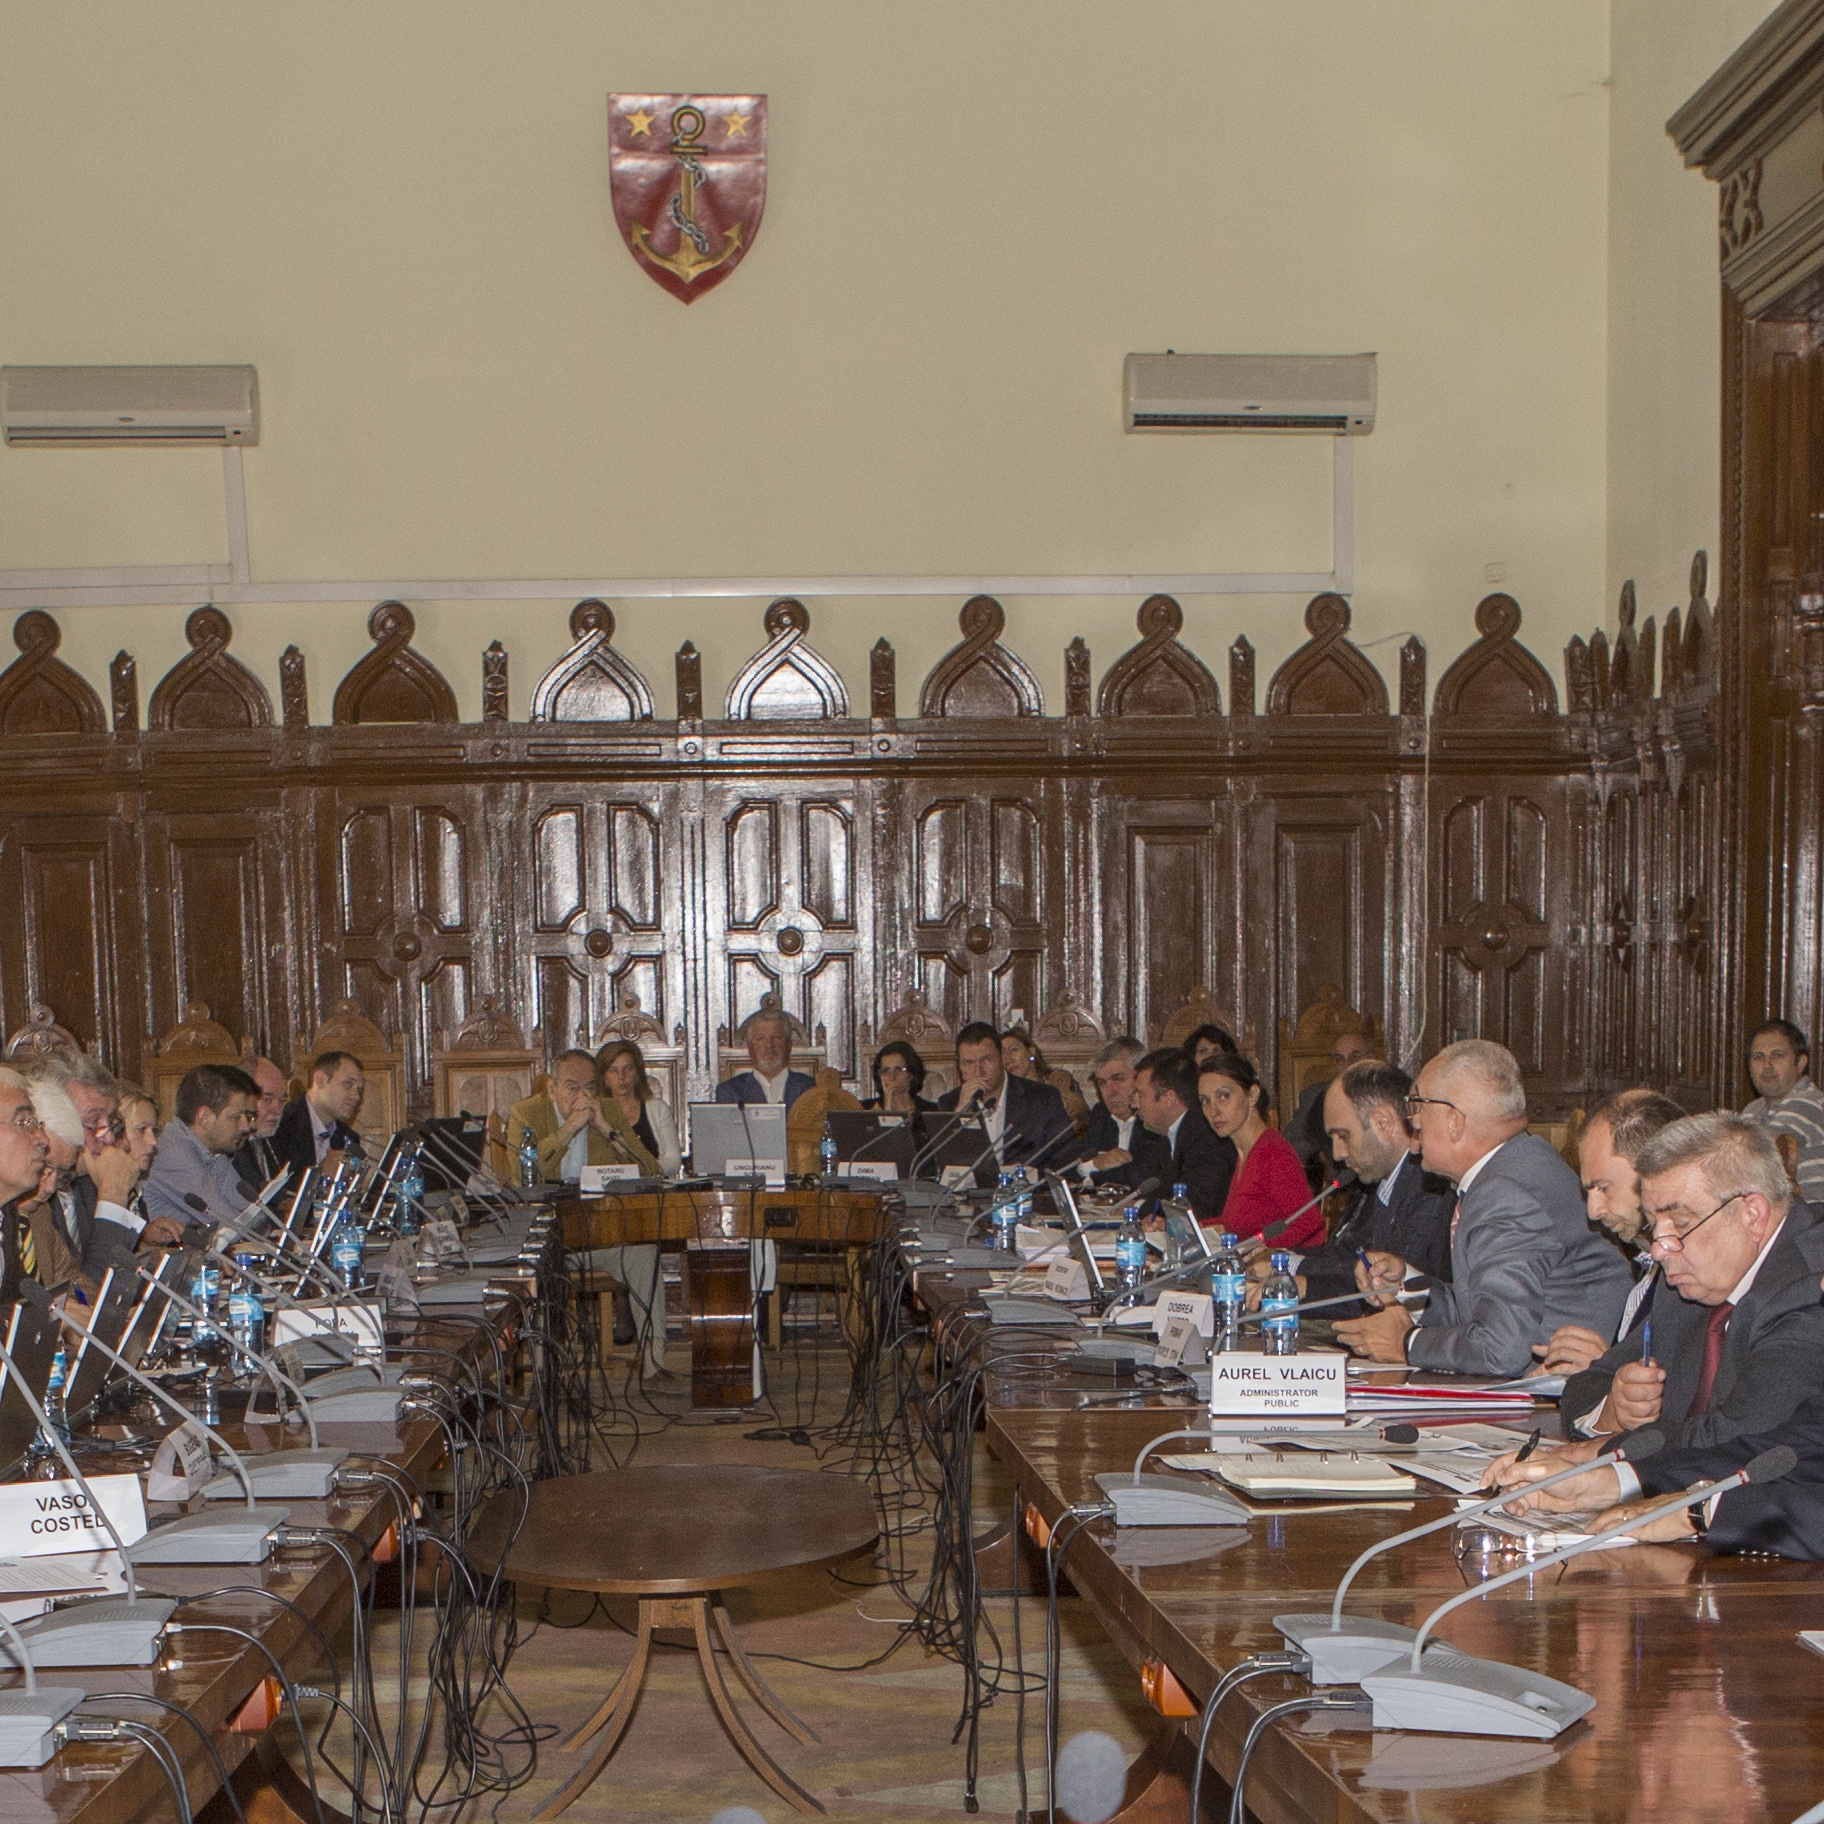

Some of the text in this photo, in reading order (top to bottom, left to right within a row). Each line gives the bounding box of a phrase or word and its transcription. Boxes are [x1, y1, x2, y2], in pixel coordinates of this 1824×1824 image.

[1167, 1302, 1194, 1314] DOBREA
[1218, 1368, 1337, 1380] AUREL VLAICU
[1239, 1389, 1319, 1398] ADMINISTRATOR
[1264, 1399, 1300, 1408] PUBLIC
[35, 1494, 90, 1512] VASO
